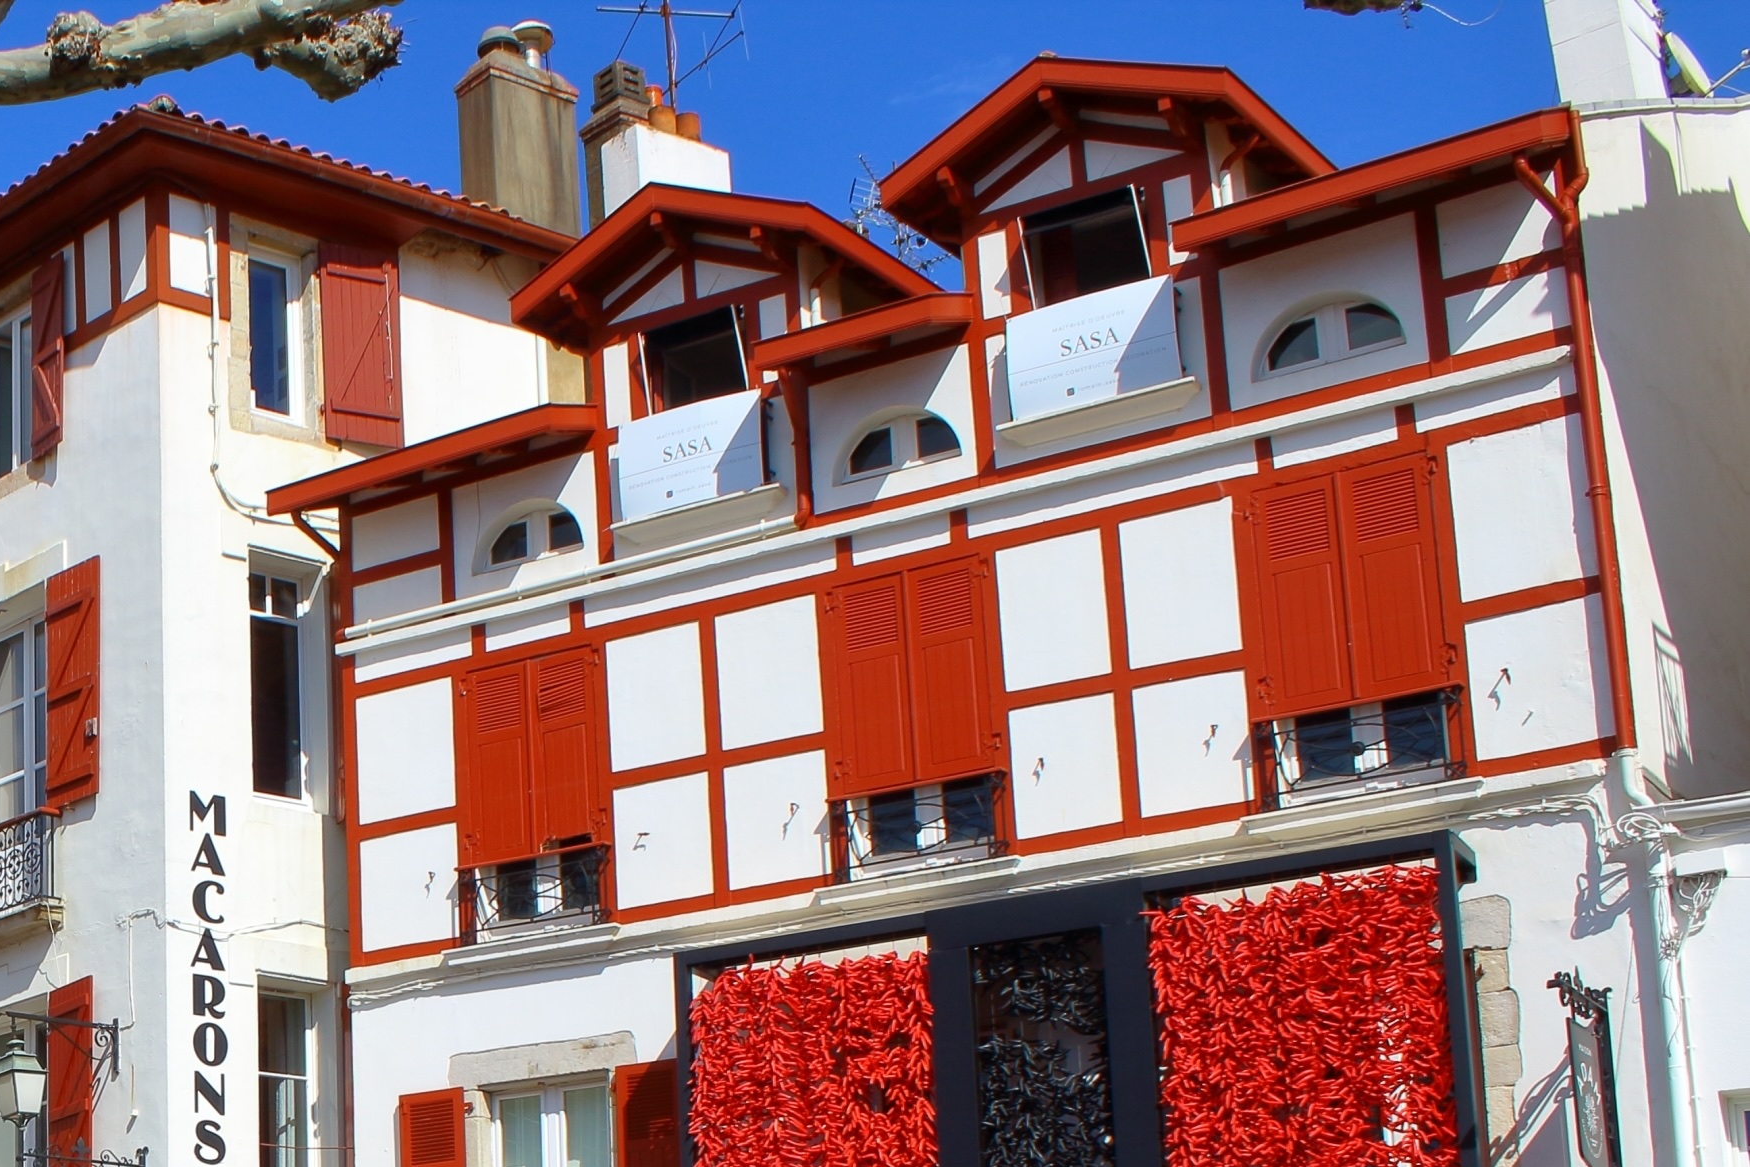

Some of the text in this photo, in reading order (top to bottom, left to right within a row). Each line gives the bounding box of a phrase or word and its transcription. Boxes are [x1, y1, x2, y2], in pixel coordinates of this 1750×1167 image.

[1061, 327, 1120, 357] SASA
[662, 436, 712, 463] SASA
[189, 790, 228, 1166] MACARONS
[1576, 1062, 1601, 1106] ADAM
